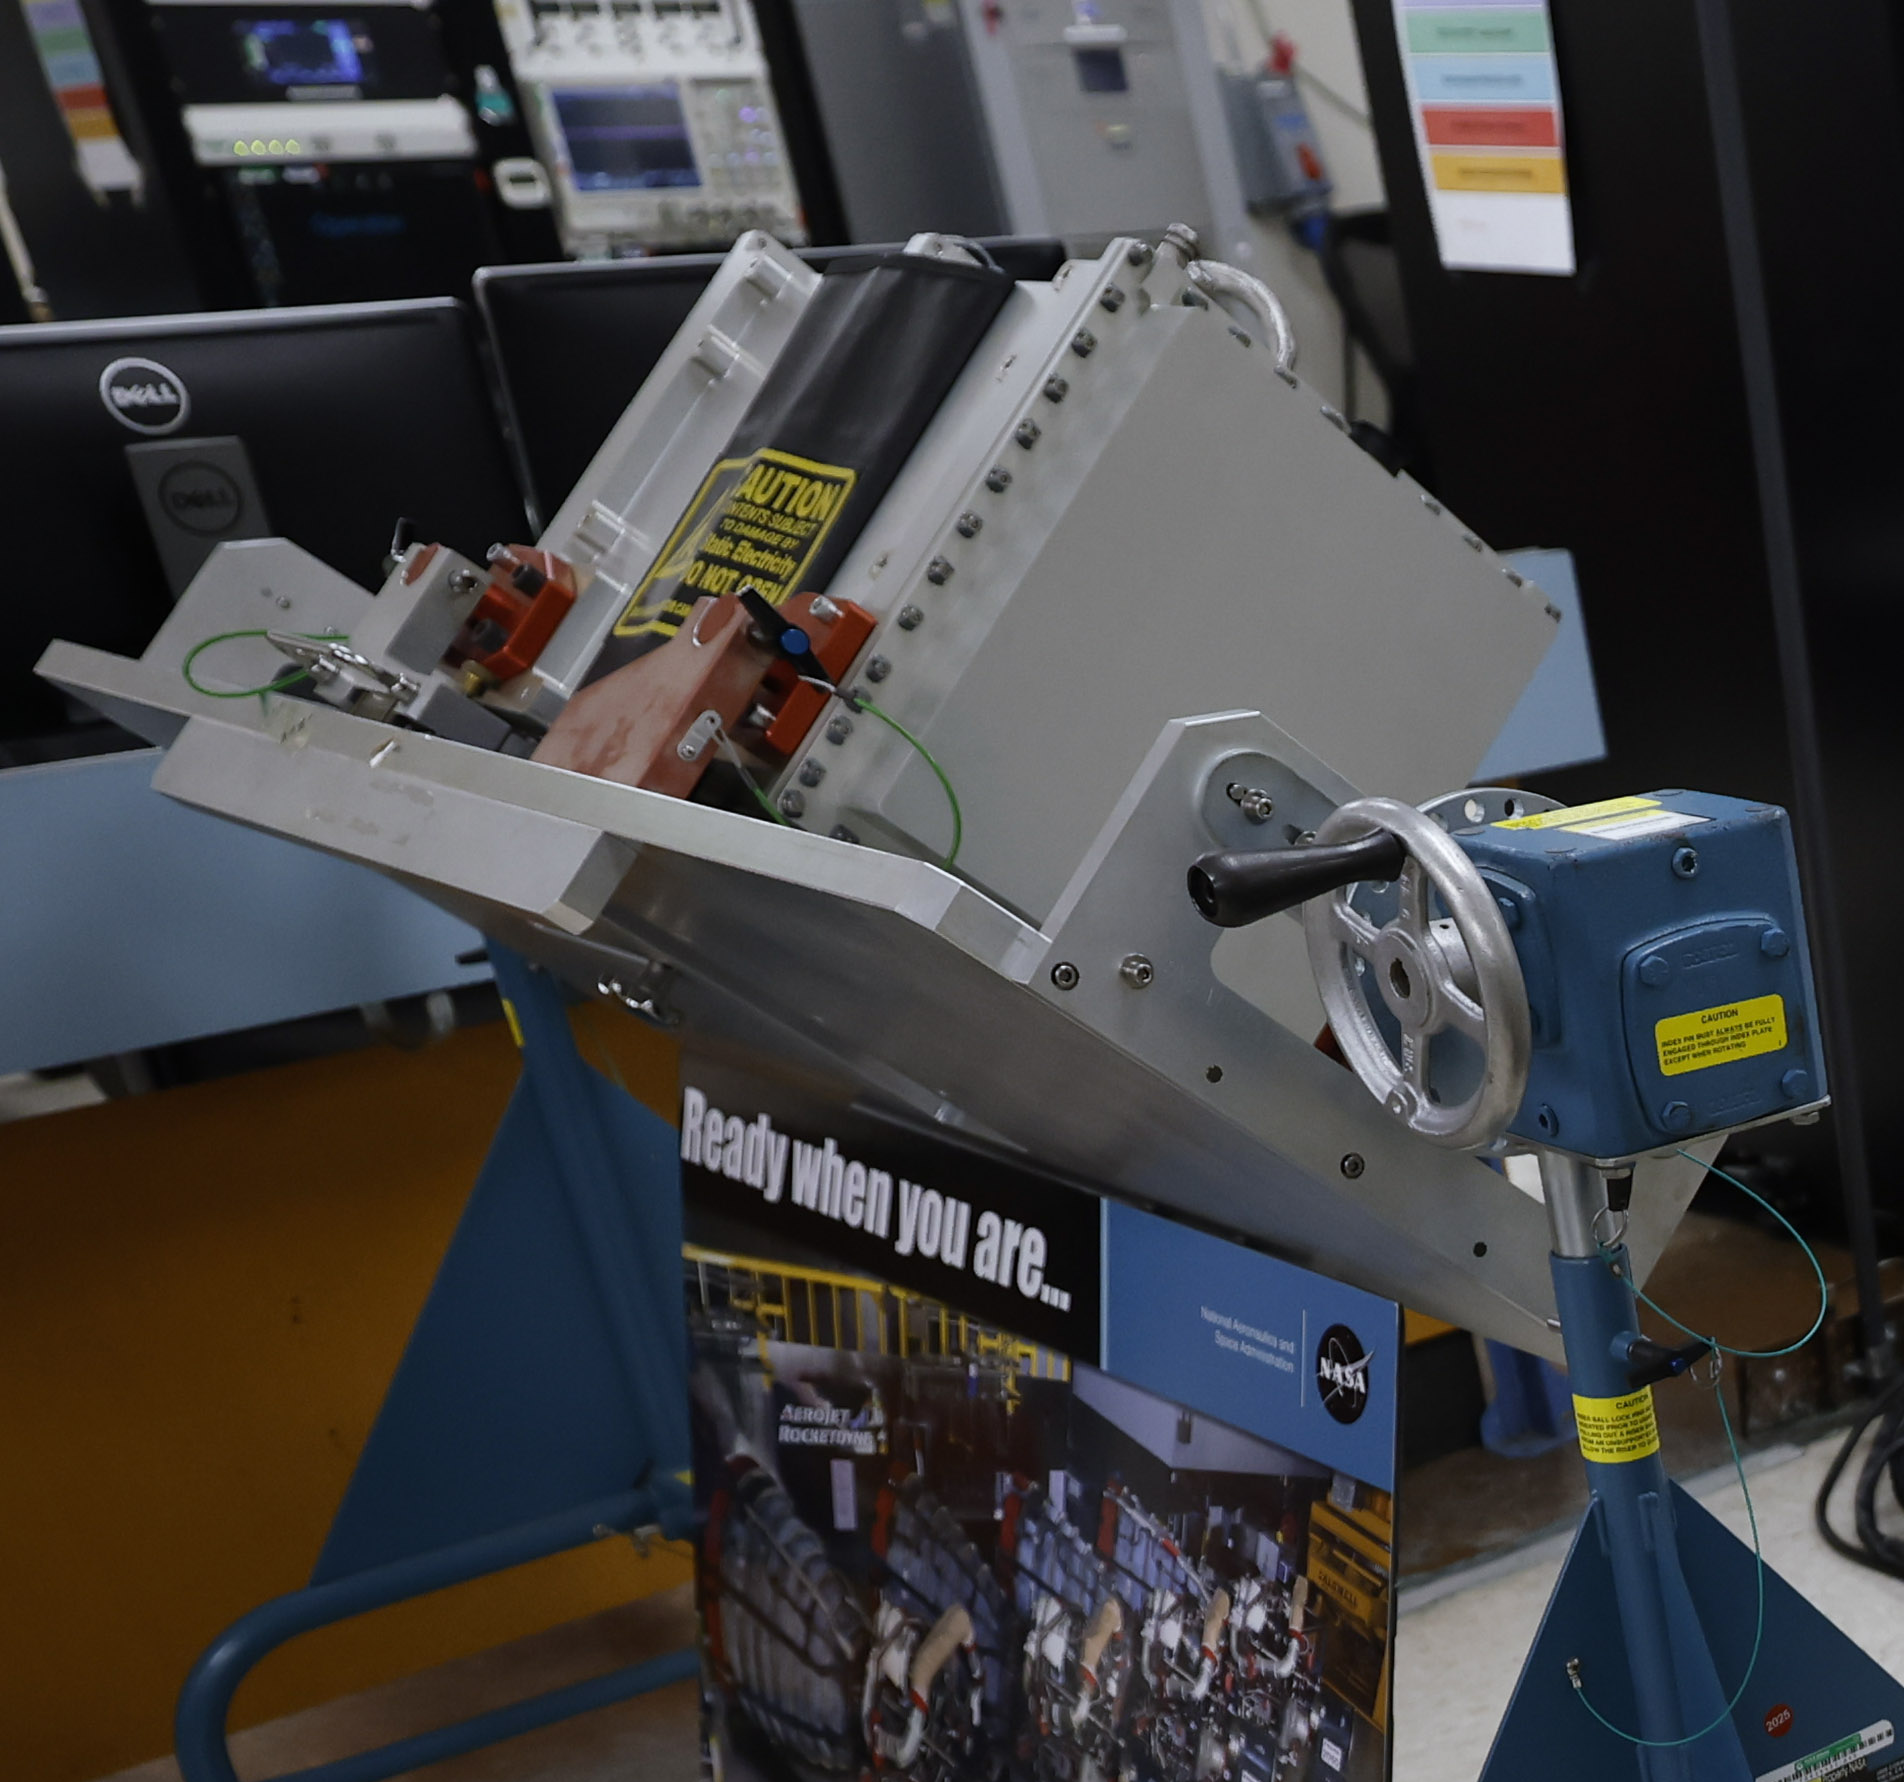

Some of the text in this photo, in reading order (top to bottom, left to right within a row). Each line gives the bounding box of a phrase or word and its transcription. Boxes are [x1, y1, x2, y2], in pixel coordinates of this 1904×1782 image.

[1701, 1008, 1739, 1024] CAUTION
[680, 1086, 1072, 1313] Ready when you are...
[1319, 1356, 1366, 1394] NASA
[1765, 1708, 1792, 1733] 2025
